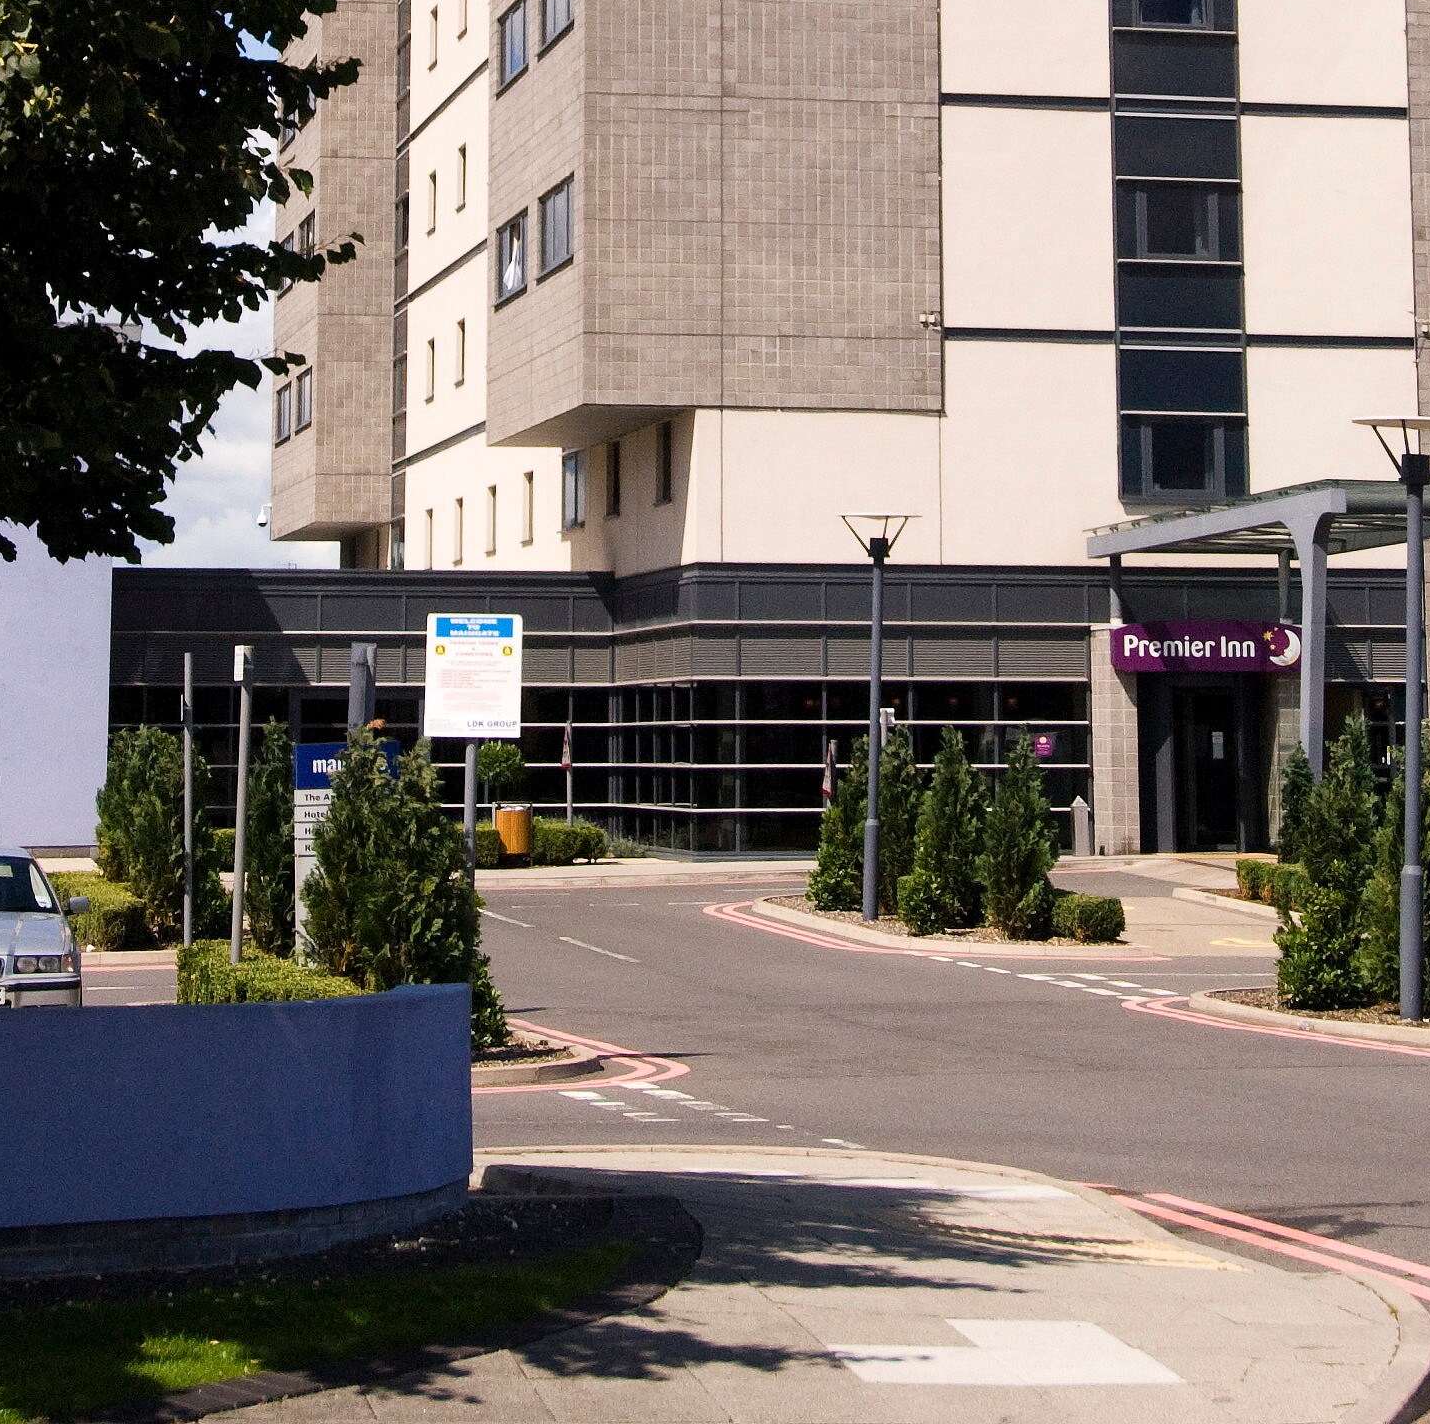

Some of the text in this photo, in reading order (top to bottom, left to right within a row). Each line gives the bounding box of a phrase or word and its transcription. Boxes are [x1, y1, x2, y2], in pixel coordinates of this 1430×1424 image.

[1123, 634, 1256, 658] Premier Inn
[467, 720, 484, 728] LDK
[487, 720, 518, 728] GROUP
[304, 794, 320, 802] The
